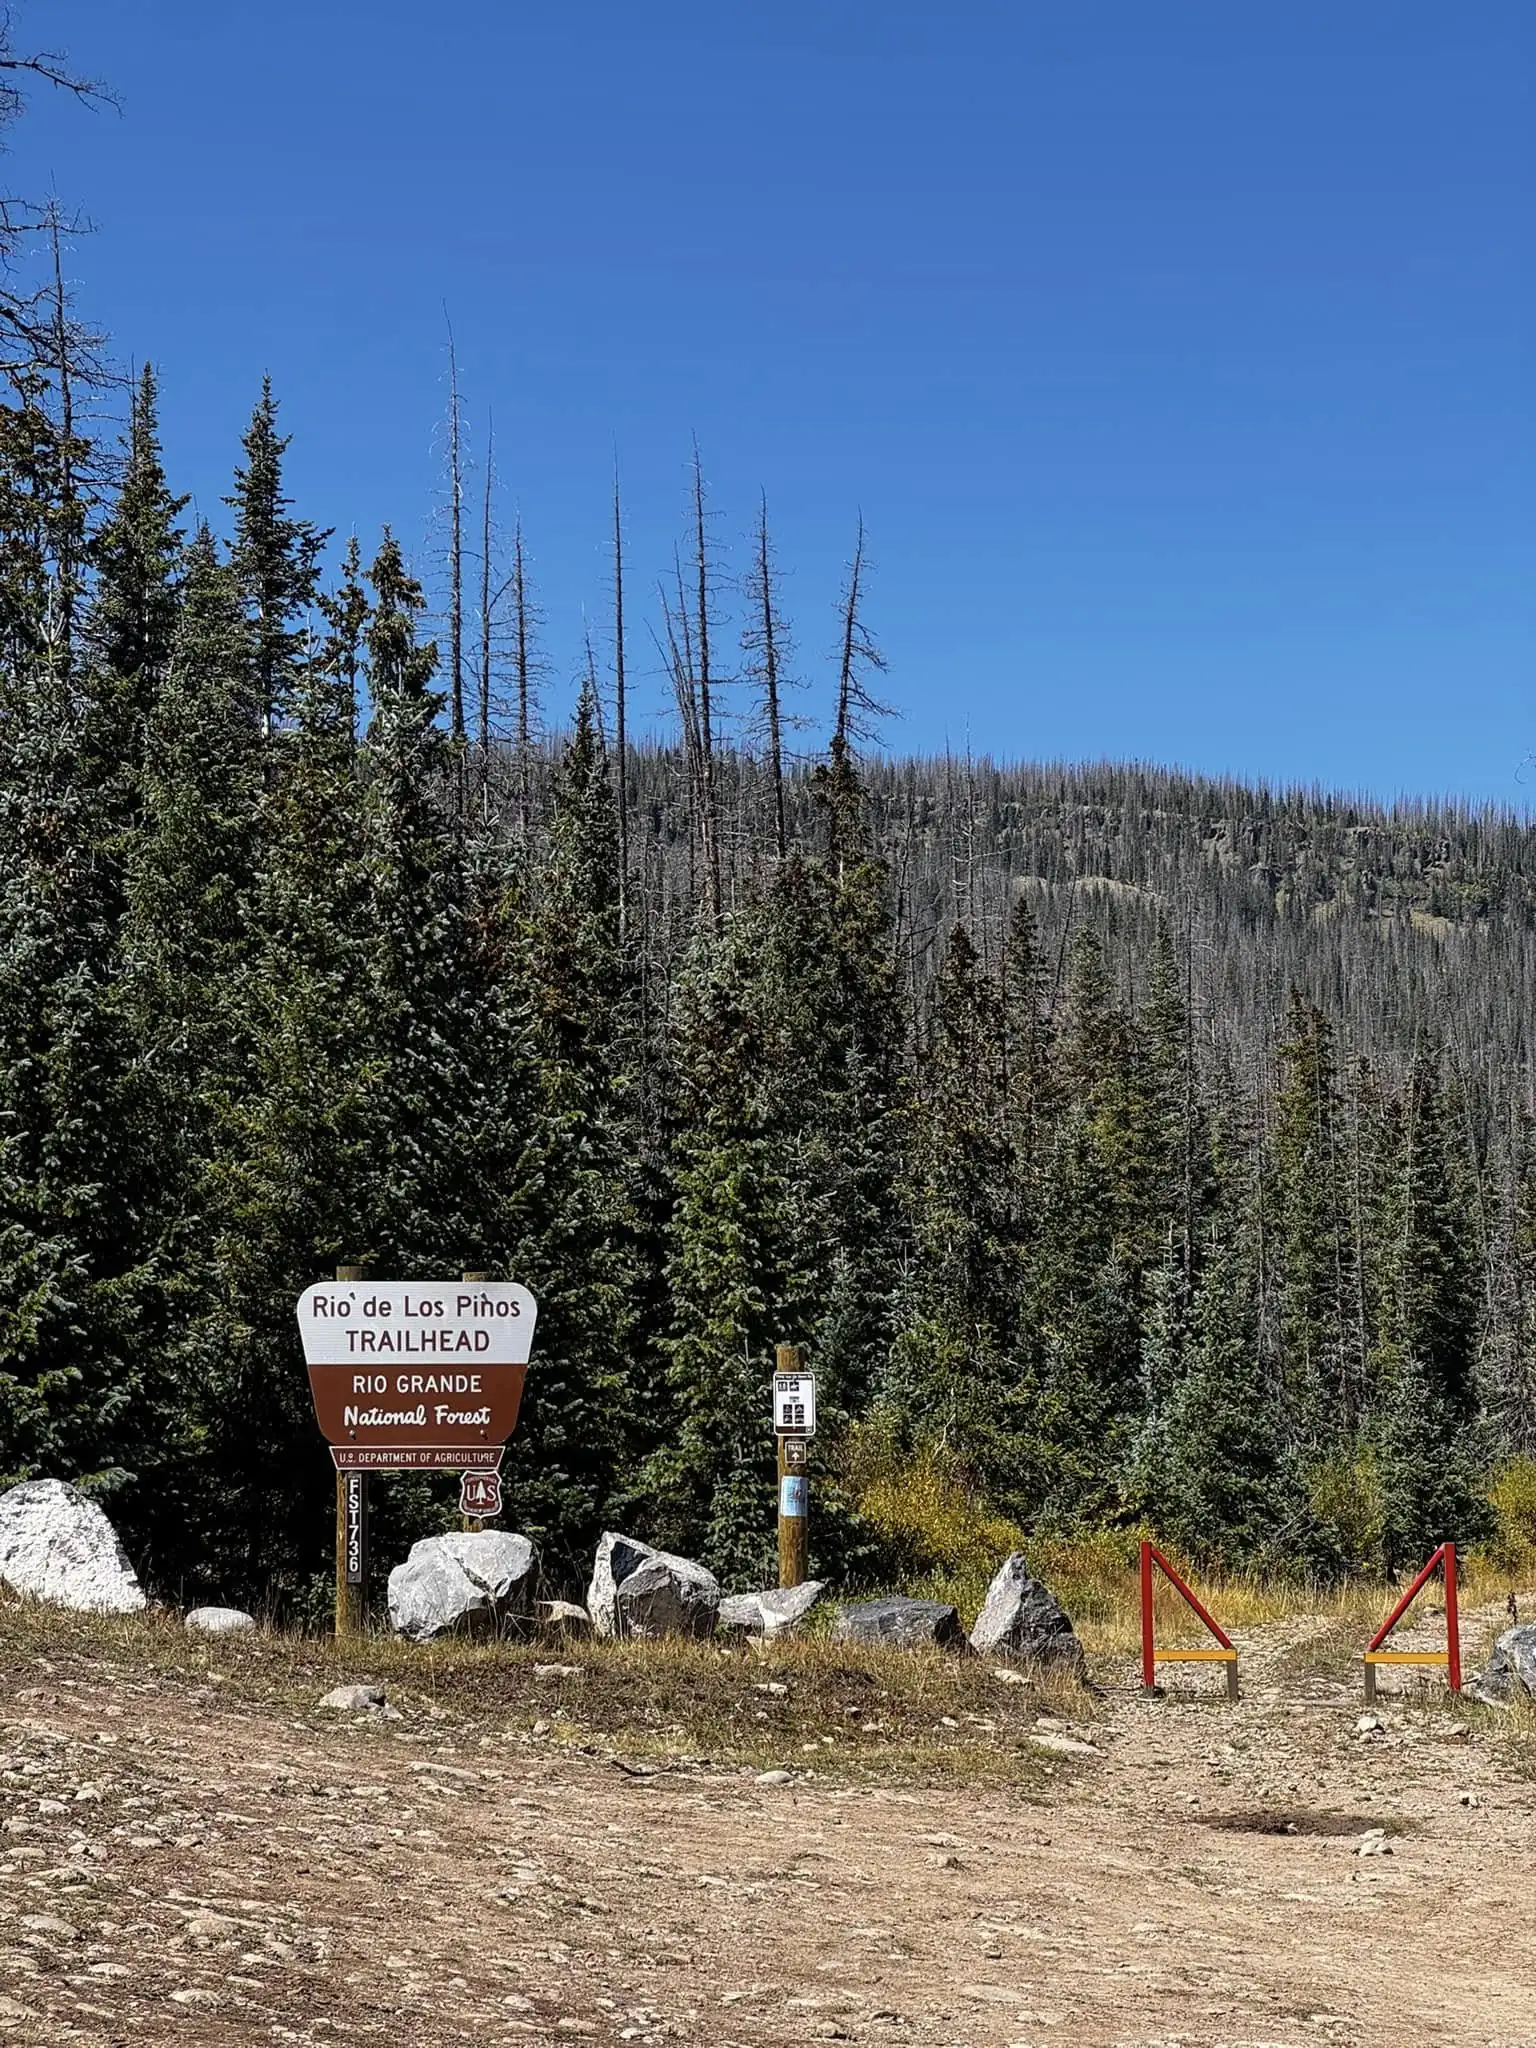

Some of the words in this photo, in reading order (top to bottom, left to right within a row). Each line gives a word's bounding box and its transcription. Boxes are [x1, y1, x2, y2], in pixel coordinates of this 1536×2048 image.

[313, 1295, 351, 1318] Rio
[363, 1295, 392, 1318] de
[404, 1295, 444, 1318] Los
[346, 1330, 490, 1352] TRAILHEAD
[353, 1375, 387, 1393] RIO
[397, 1375, 482, 1393] GRANDE
[344, 1404, 426, 1426] National
[434, 1404, 491, 1425] Forest
[339, 1453, 356, 1463] U.S.
[358, 1452, 416, 1463] DEPARTMENT
[420, 1452, 431, 1463] OF
[434, 1452, 495, 1463] AGRICULTURE
